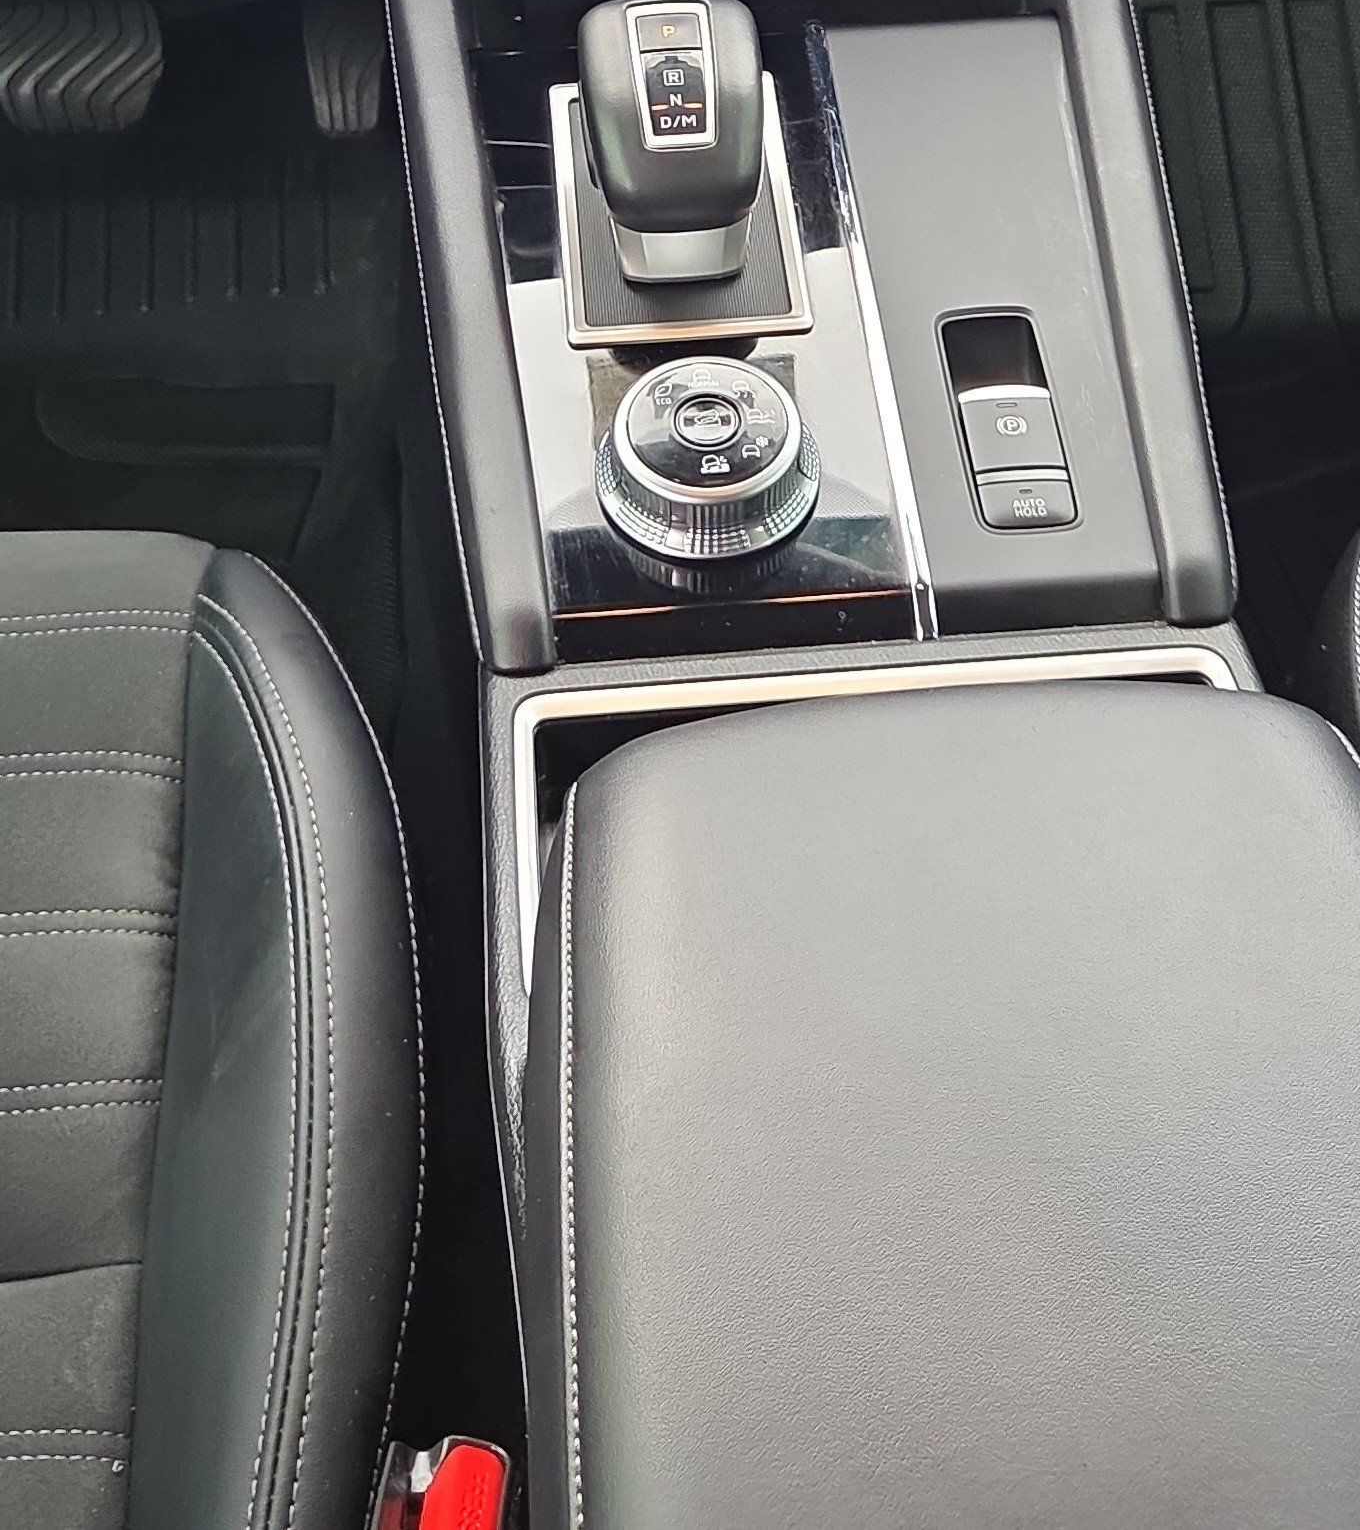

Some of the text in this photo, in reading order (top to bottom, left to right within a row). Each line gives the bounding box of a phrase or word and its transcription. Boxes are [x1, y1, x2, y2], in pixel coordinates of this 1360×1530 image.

[662, 25, 676, 38] P
[669, 93, 683, 107] N
[660, 114, 697, 129] D/M
[686, 379, 720, 389] NORMAL
[655, 397, 672, 405] ECO
[1012, 498, 1046, 508] AUTO
[1014, 506, 1047, 518] HOLD
